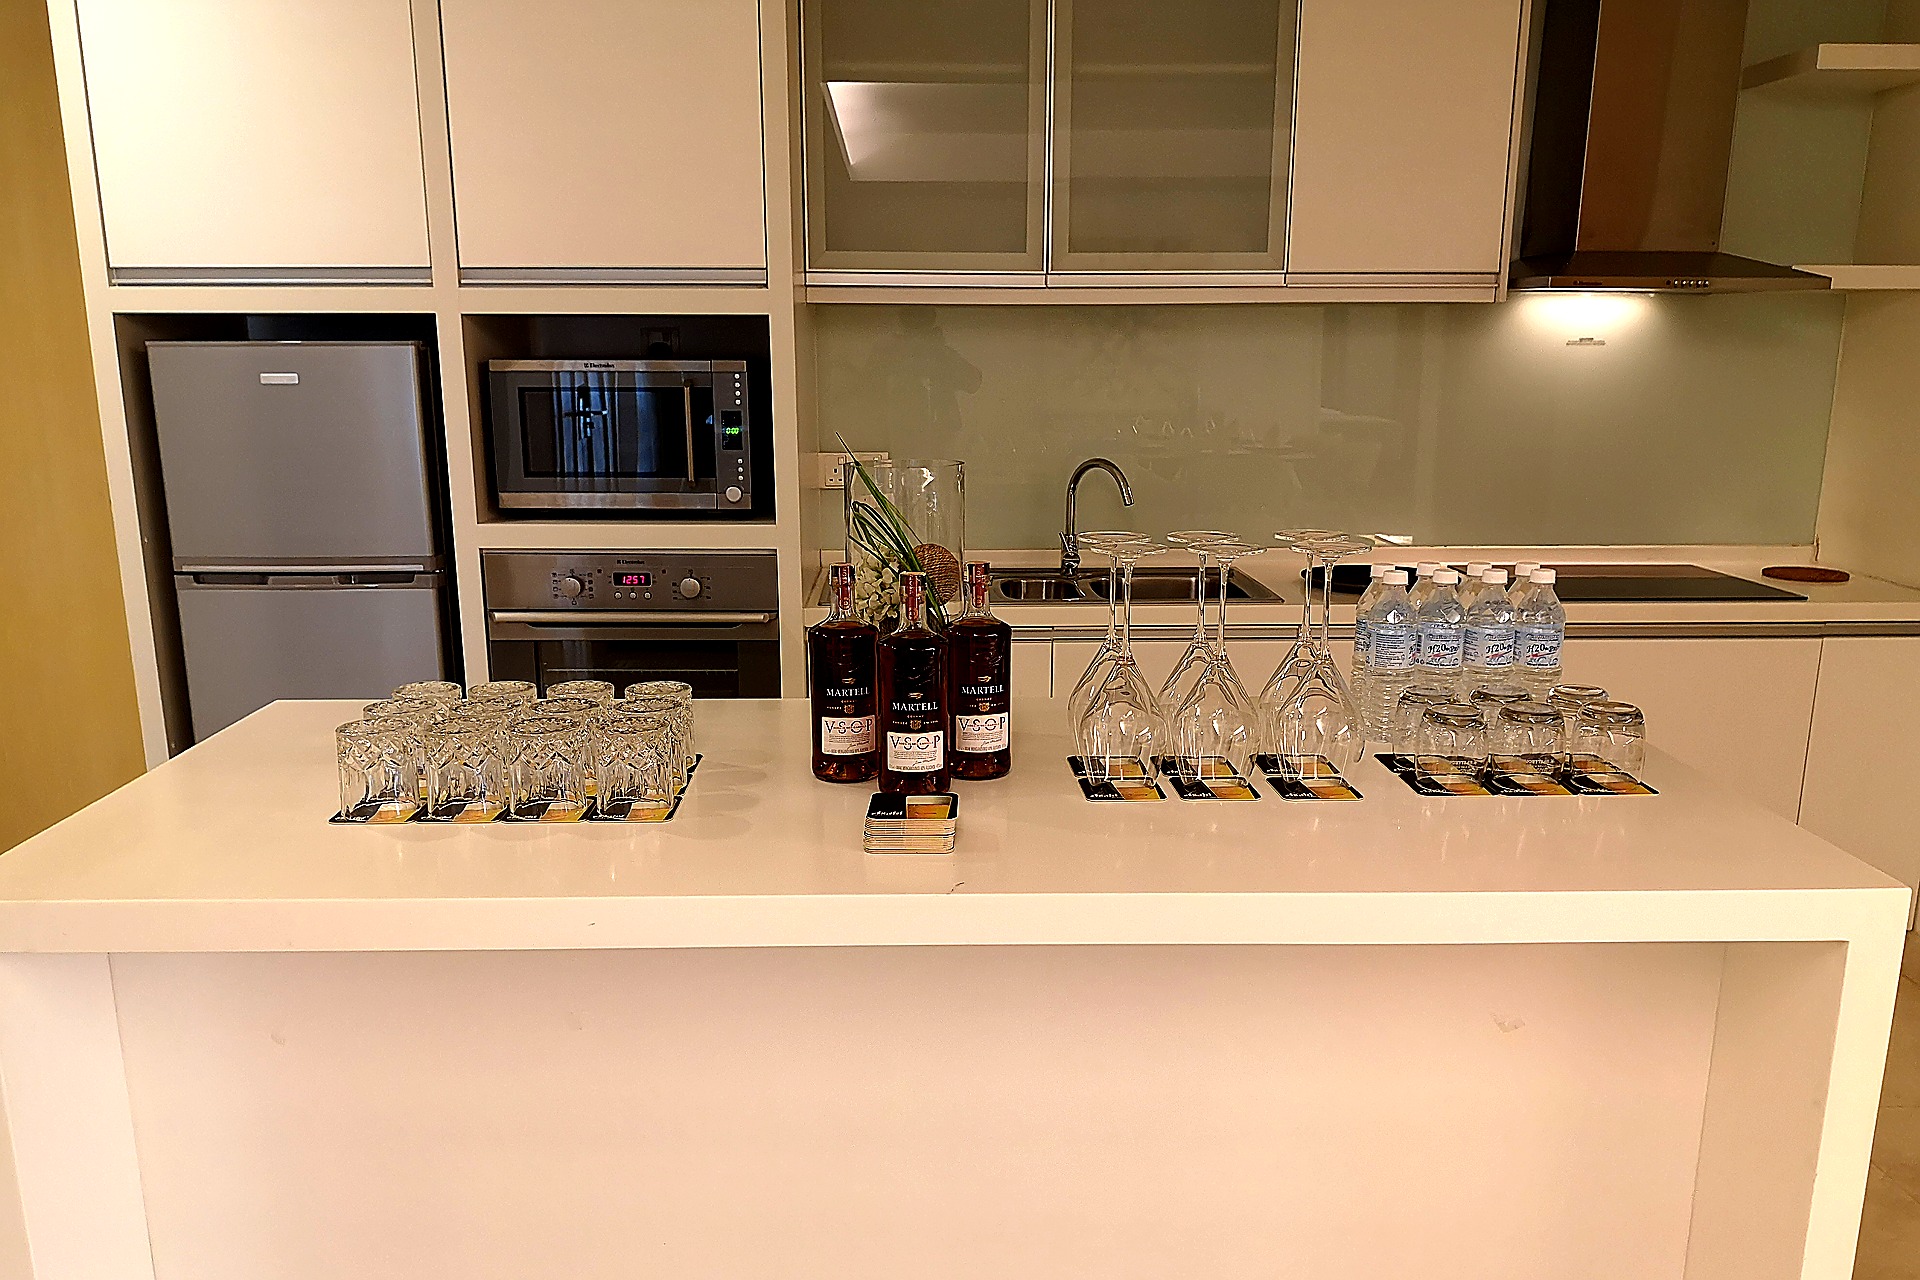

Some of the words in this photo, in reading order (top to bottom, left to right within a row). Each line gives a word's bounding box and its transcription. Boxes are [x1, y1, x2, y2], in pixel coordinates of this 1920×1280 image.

[826, 686, 871, 697] MARTELL
[961, 684, 1005, 695] MARTELL
[892, 701, 939, 712] MARTELL
